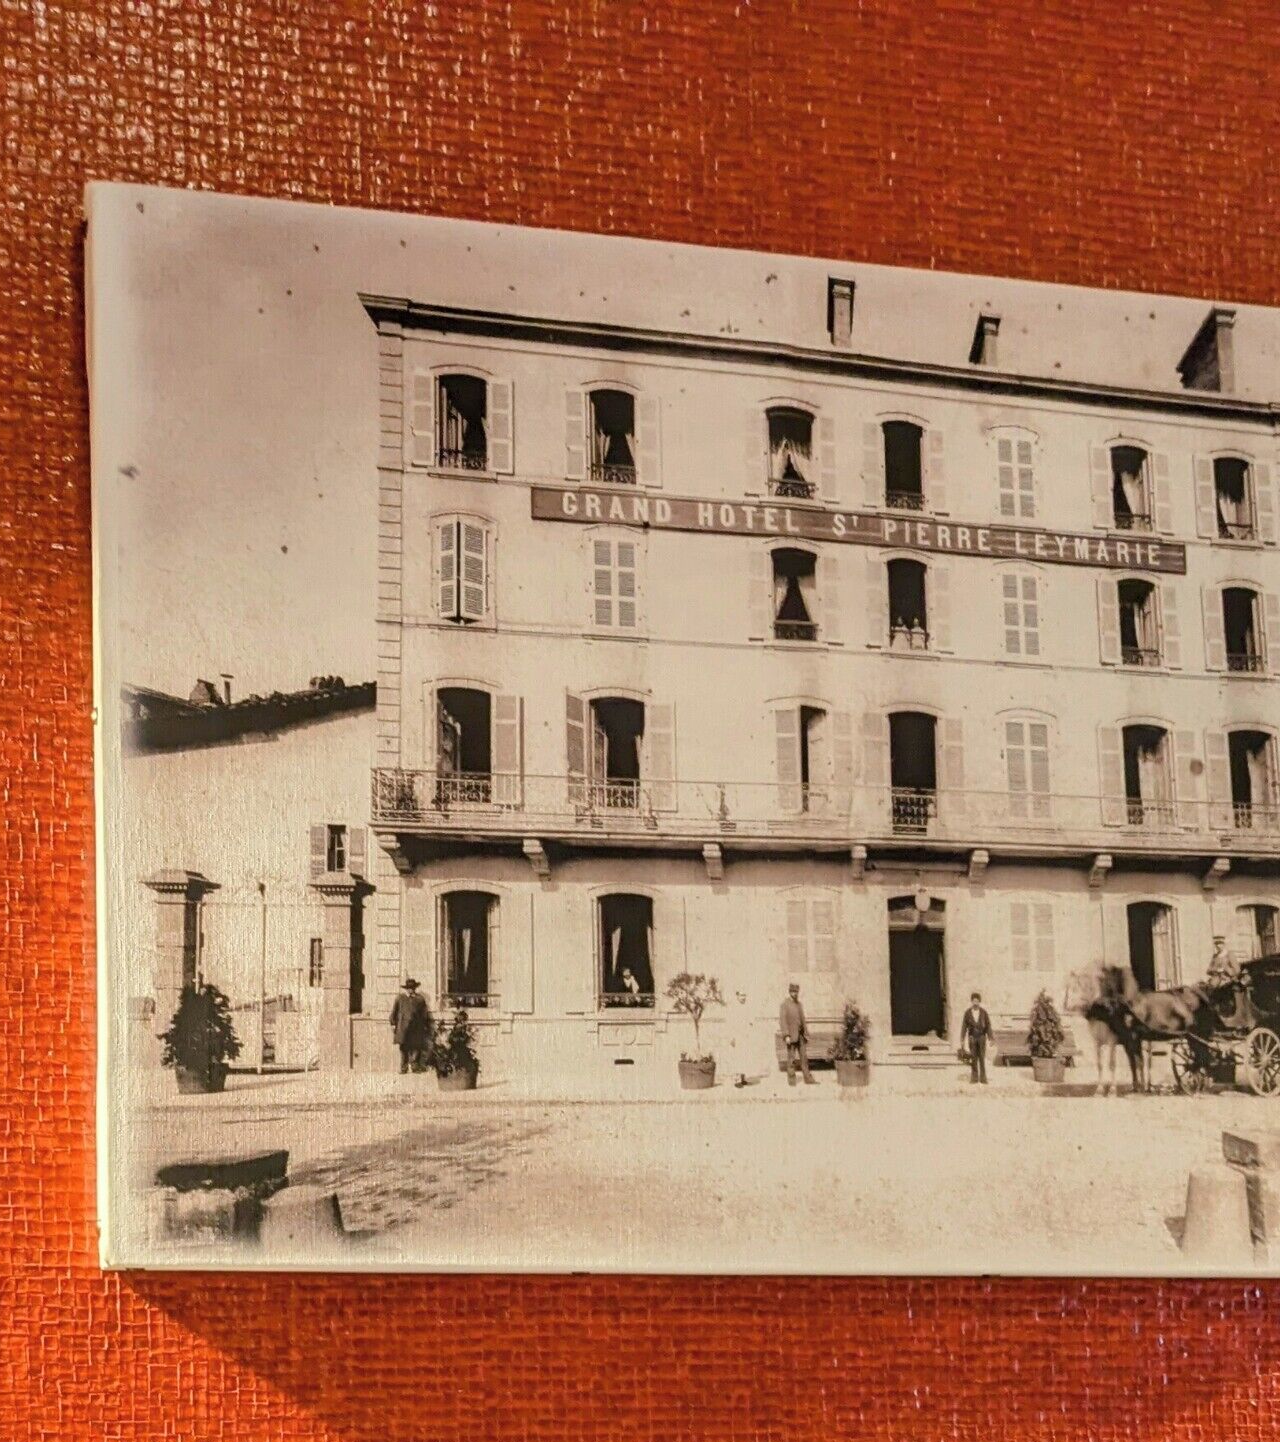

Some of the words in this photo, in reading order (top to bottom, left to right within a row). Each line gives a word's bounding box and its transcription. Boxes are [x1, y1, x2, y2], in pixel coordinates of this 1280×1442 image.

[561, 491, 672, 524] GRAND
[697, 502, 800, 533] HOTEL
[883, 521, 992, 553] PIERRE
[1013, 532, 1162, 566] LEYMARIE
